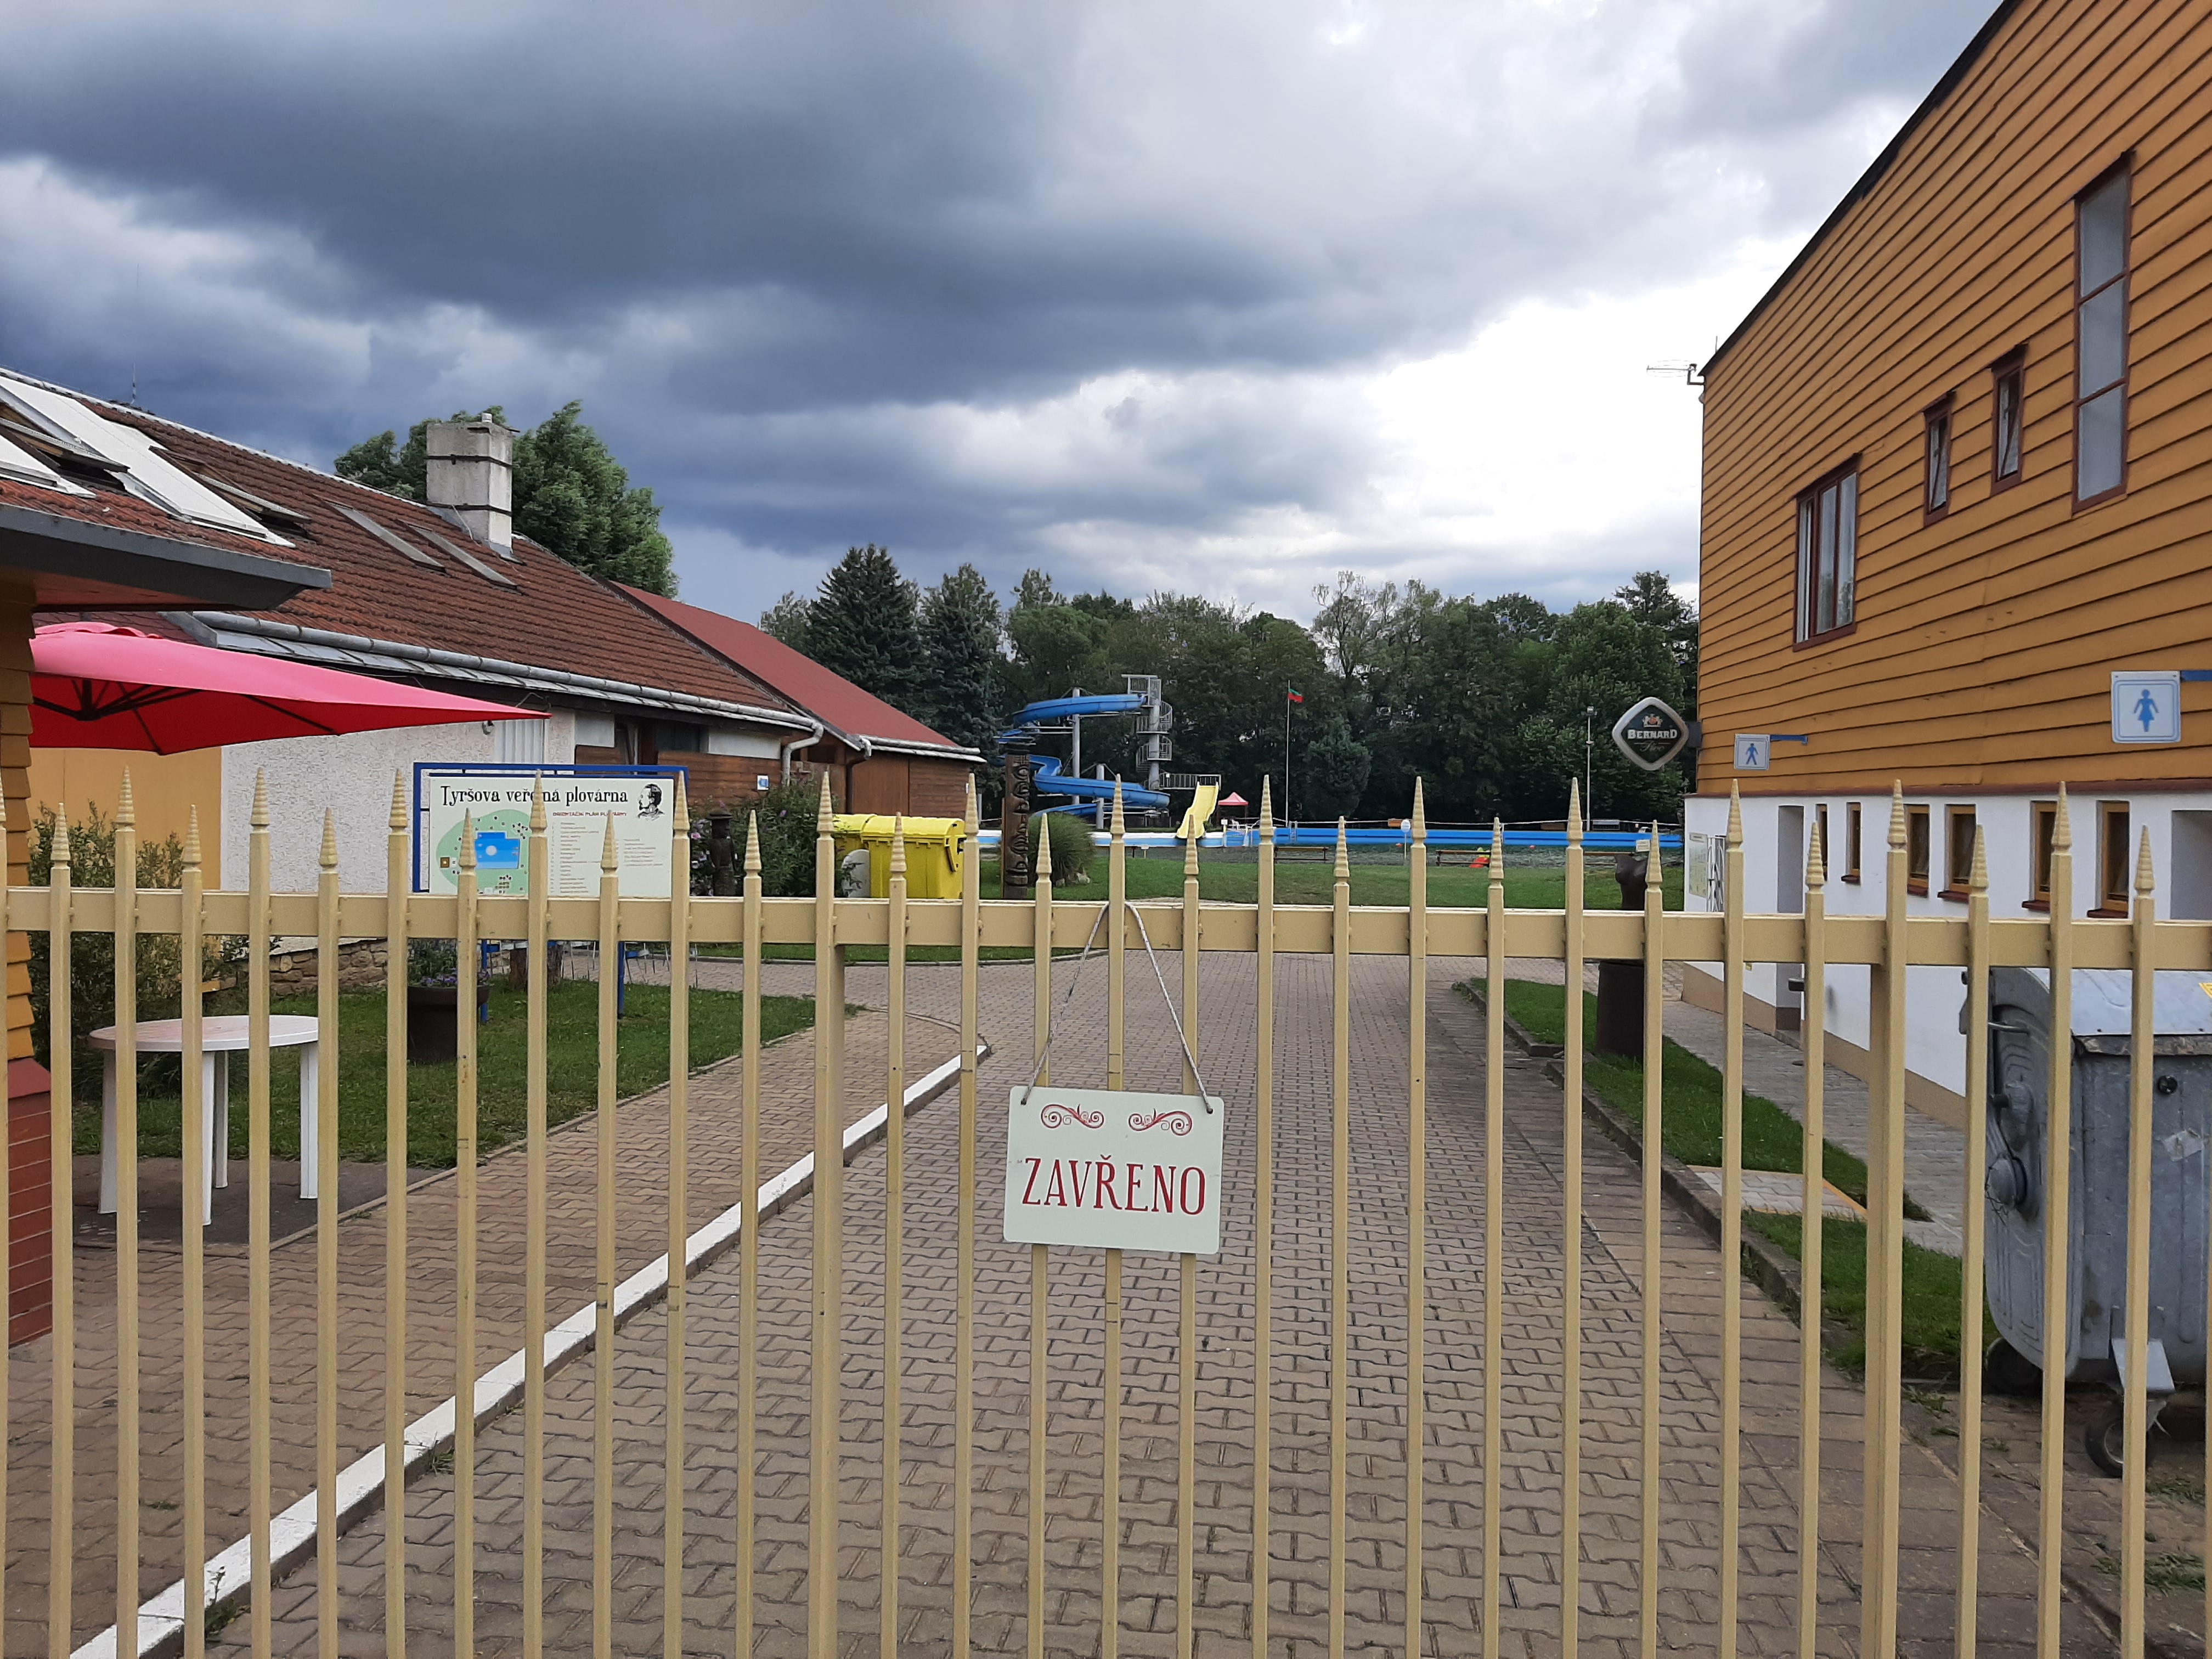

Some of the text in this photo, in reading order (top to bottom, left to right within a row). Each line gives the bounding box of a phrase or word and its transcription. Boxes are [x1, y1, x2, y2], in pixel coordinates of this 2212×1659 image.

[1628, 729, 1677, 738] BERNARD
[441, 786, 500, 805] Tyršova
[566, 786, 628, 806] plovárna
[1022, 1154, 1206, 1215] ZAVŘENO
